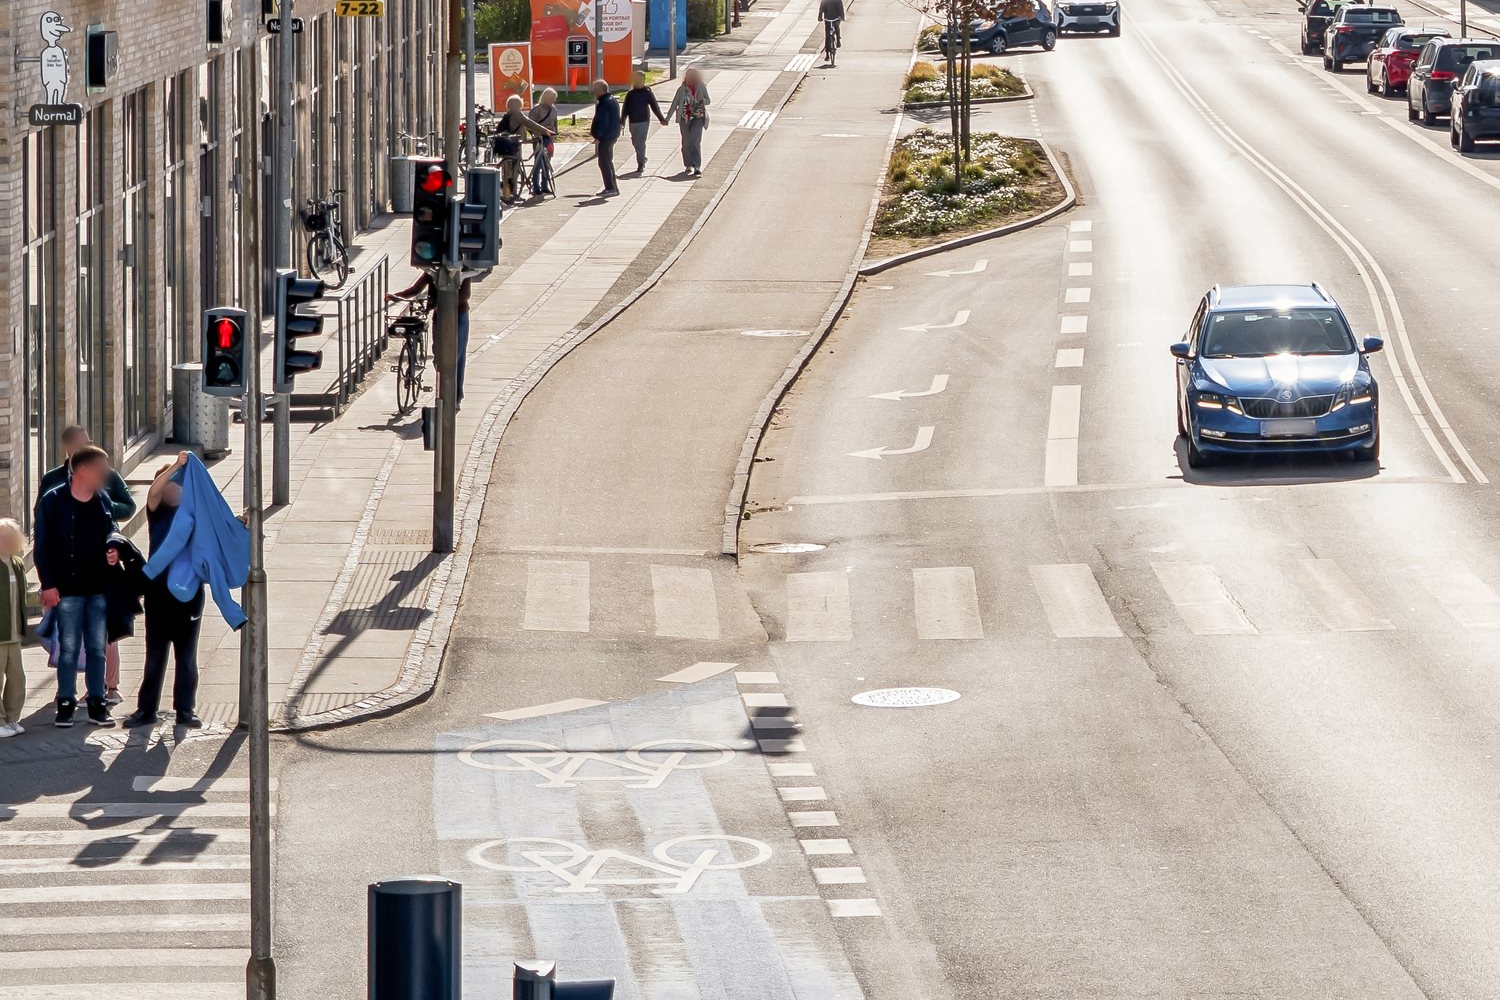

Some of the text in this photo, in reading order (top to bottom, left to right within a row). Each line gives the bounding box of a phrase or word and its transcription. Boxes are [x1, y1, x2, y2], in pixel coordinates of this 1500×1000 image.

[340, 2, 380, 15] 7-22
[270, 22, 300, 30] Noal
[35, 108, 76, 121] Normal
